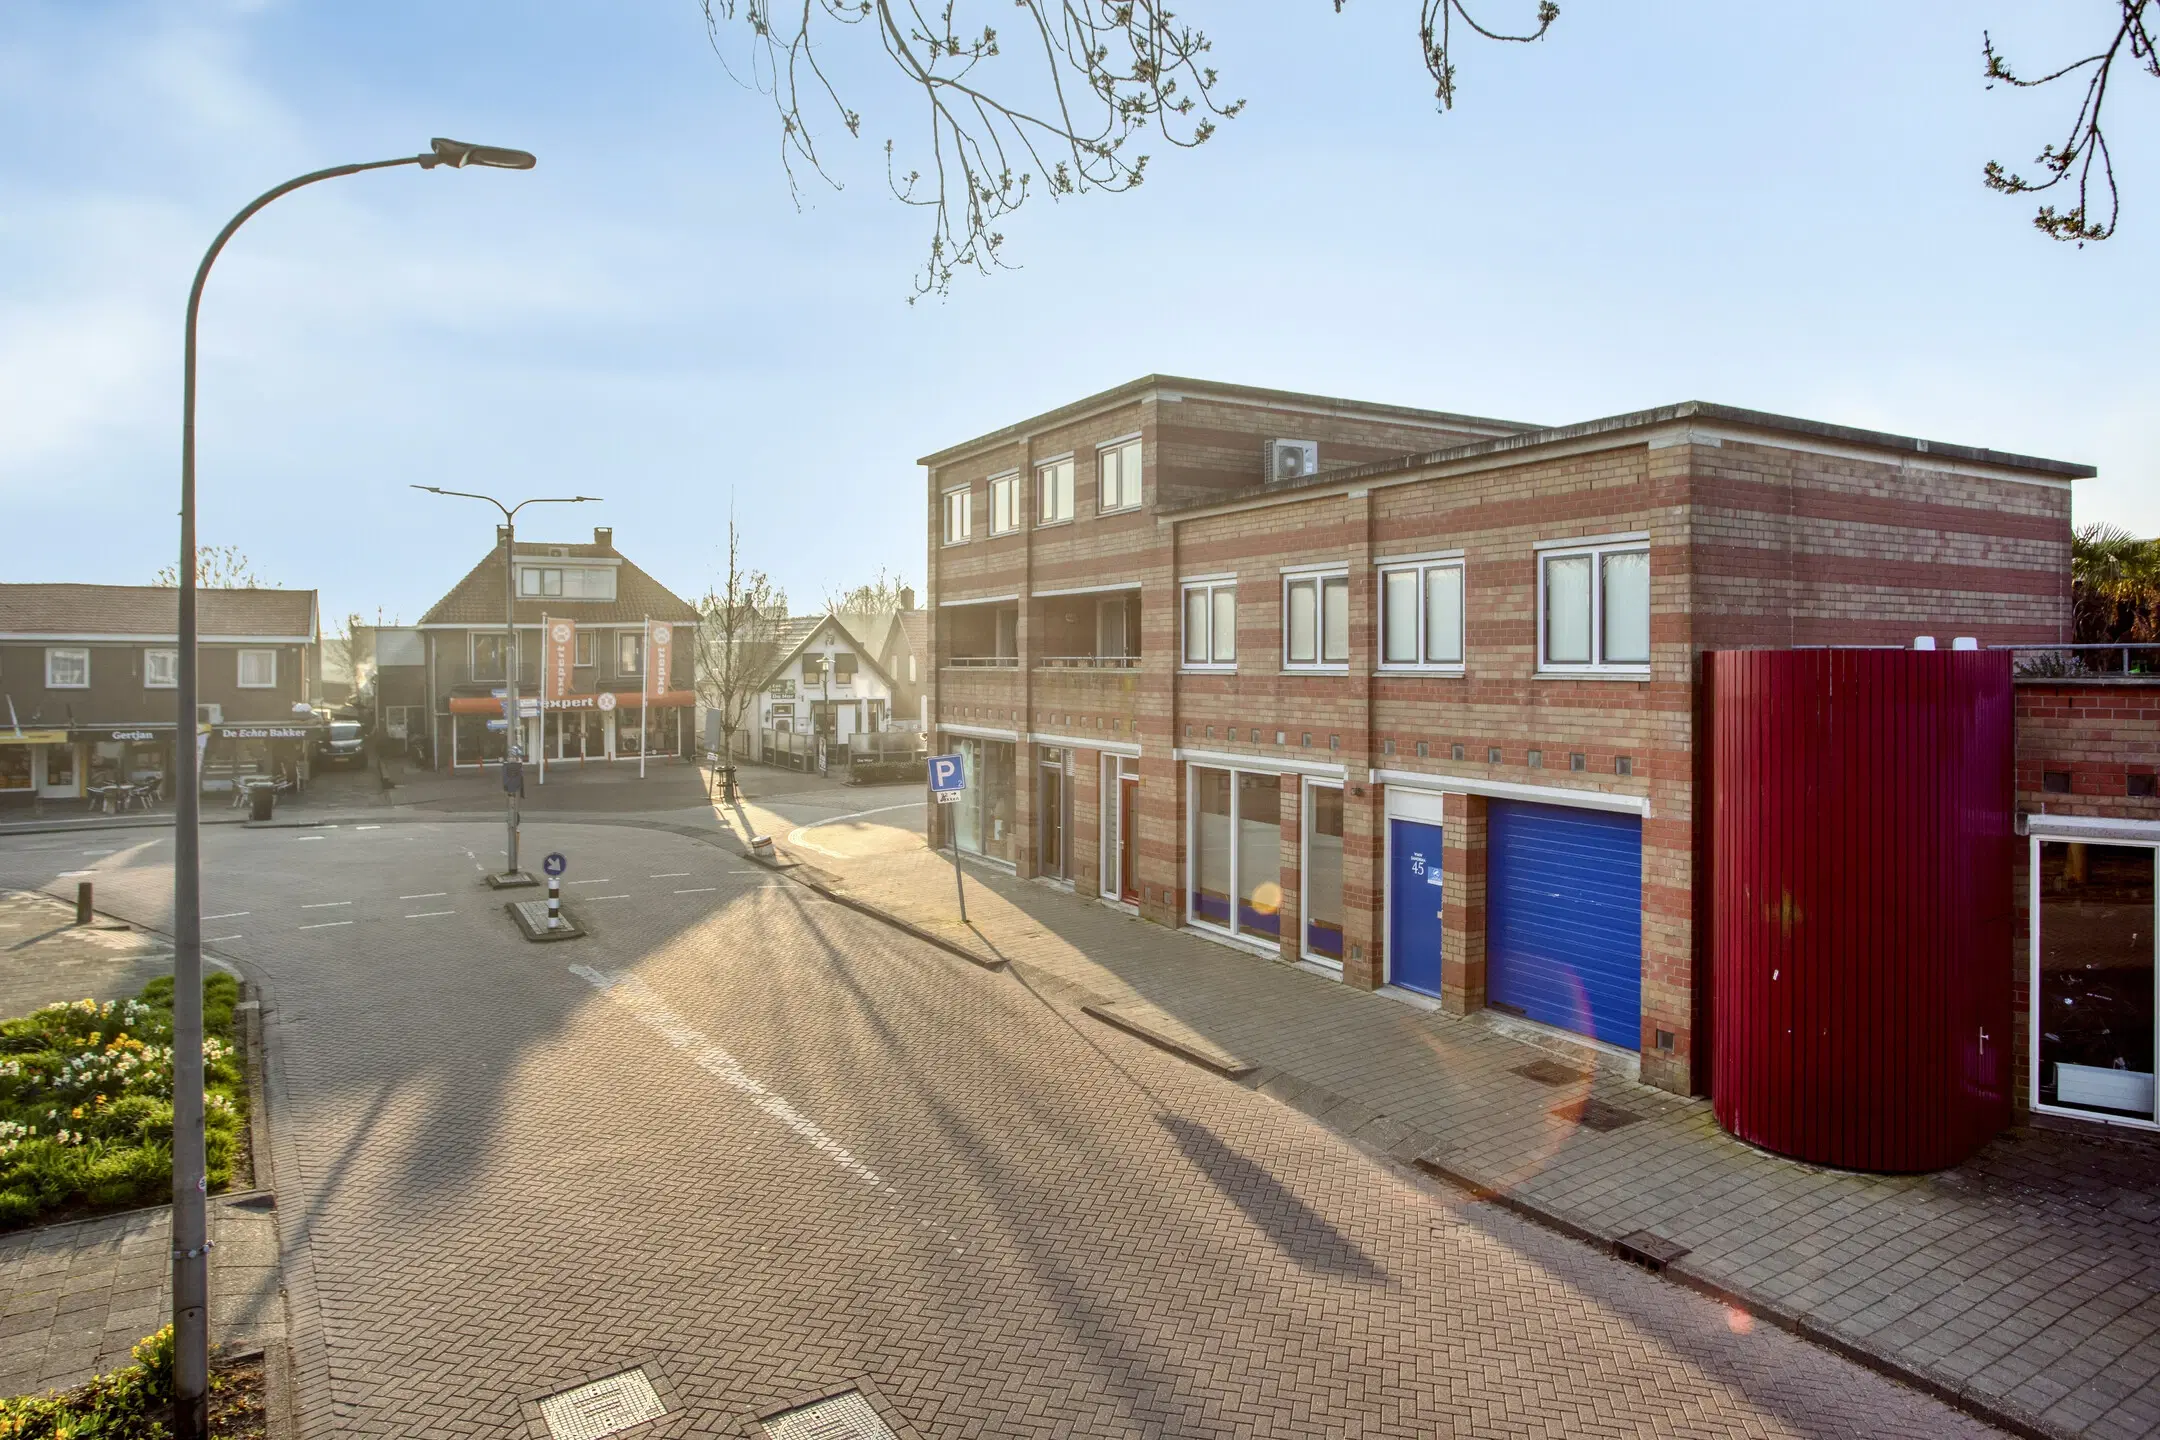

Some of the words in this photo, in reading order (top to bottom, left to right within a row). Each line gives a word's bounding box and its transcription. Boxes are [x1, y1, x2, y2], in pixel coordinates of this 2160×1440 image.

[557, 645, 565, 697] expert
[657, 647, 666, 696] expert
[541, 698, 594, 709] expert
[112, 731, 153, 741] Gertjan
[223, 729, 237, 738] De
[238, 728, 268, 738] Echte
[269, 728, 307, 738] Bakker
[936, 760, 955, 787] P
[1411, 861, 1424, 875] 45
